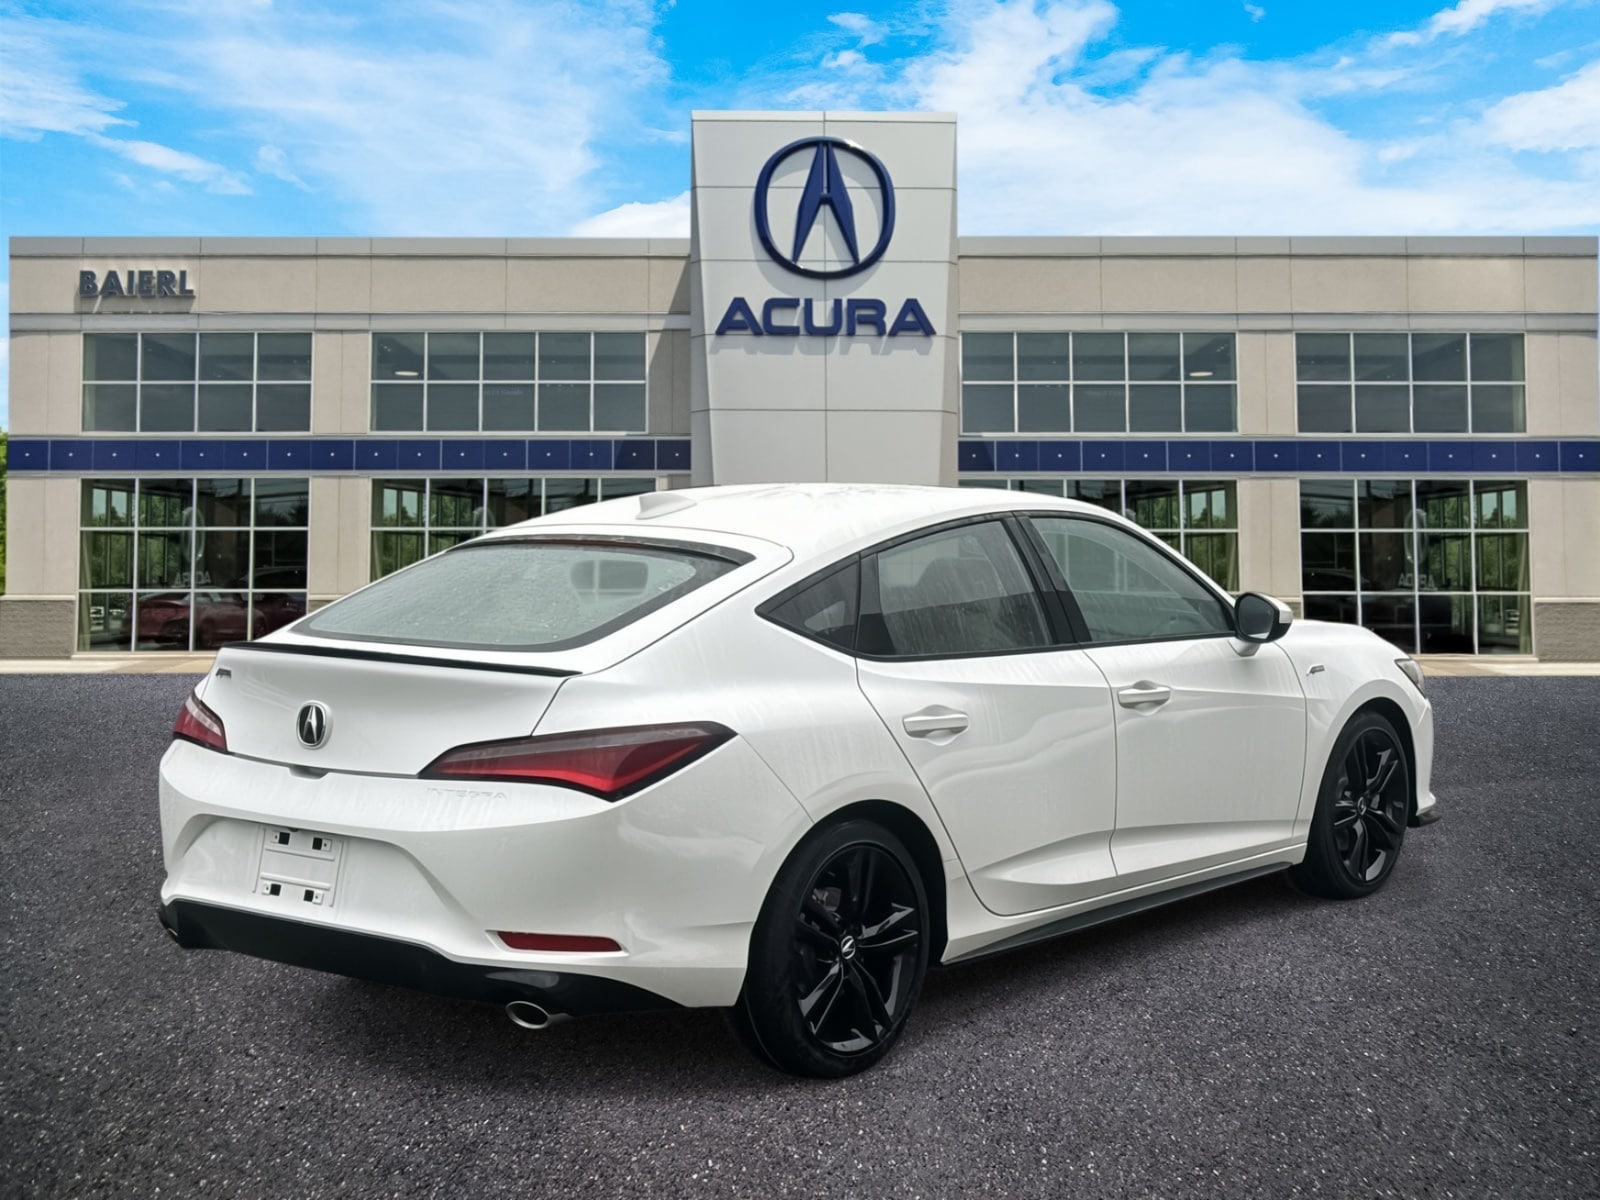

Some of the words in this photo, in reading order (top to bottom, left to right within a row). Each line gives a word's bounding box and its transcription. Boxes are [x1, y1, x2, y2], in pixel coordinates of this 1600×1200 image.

[79, 270, 195, 297] BAIERL
[715, 297, 936, 336] ACURA
[1398, 572, 1435, 588] ACRA
